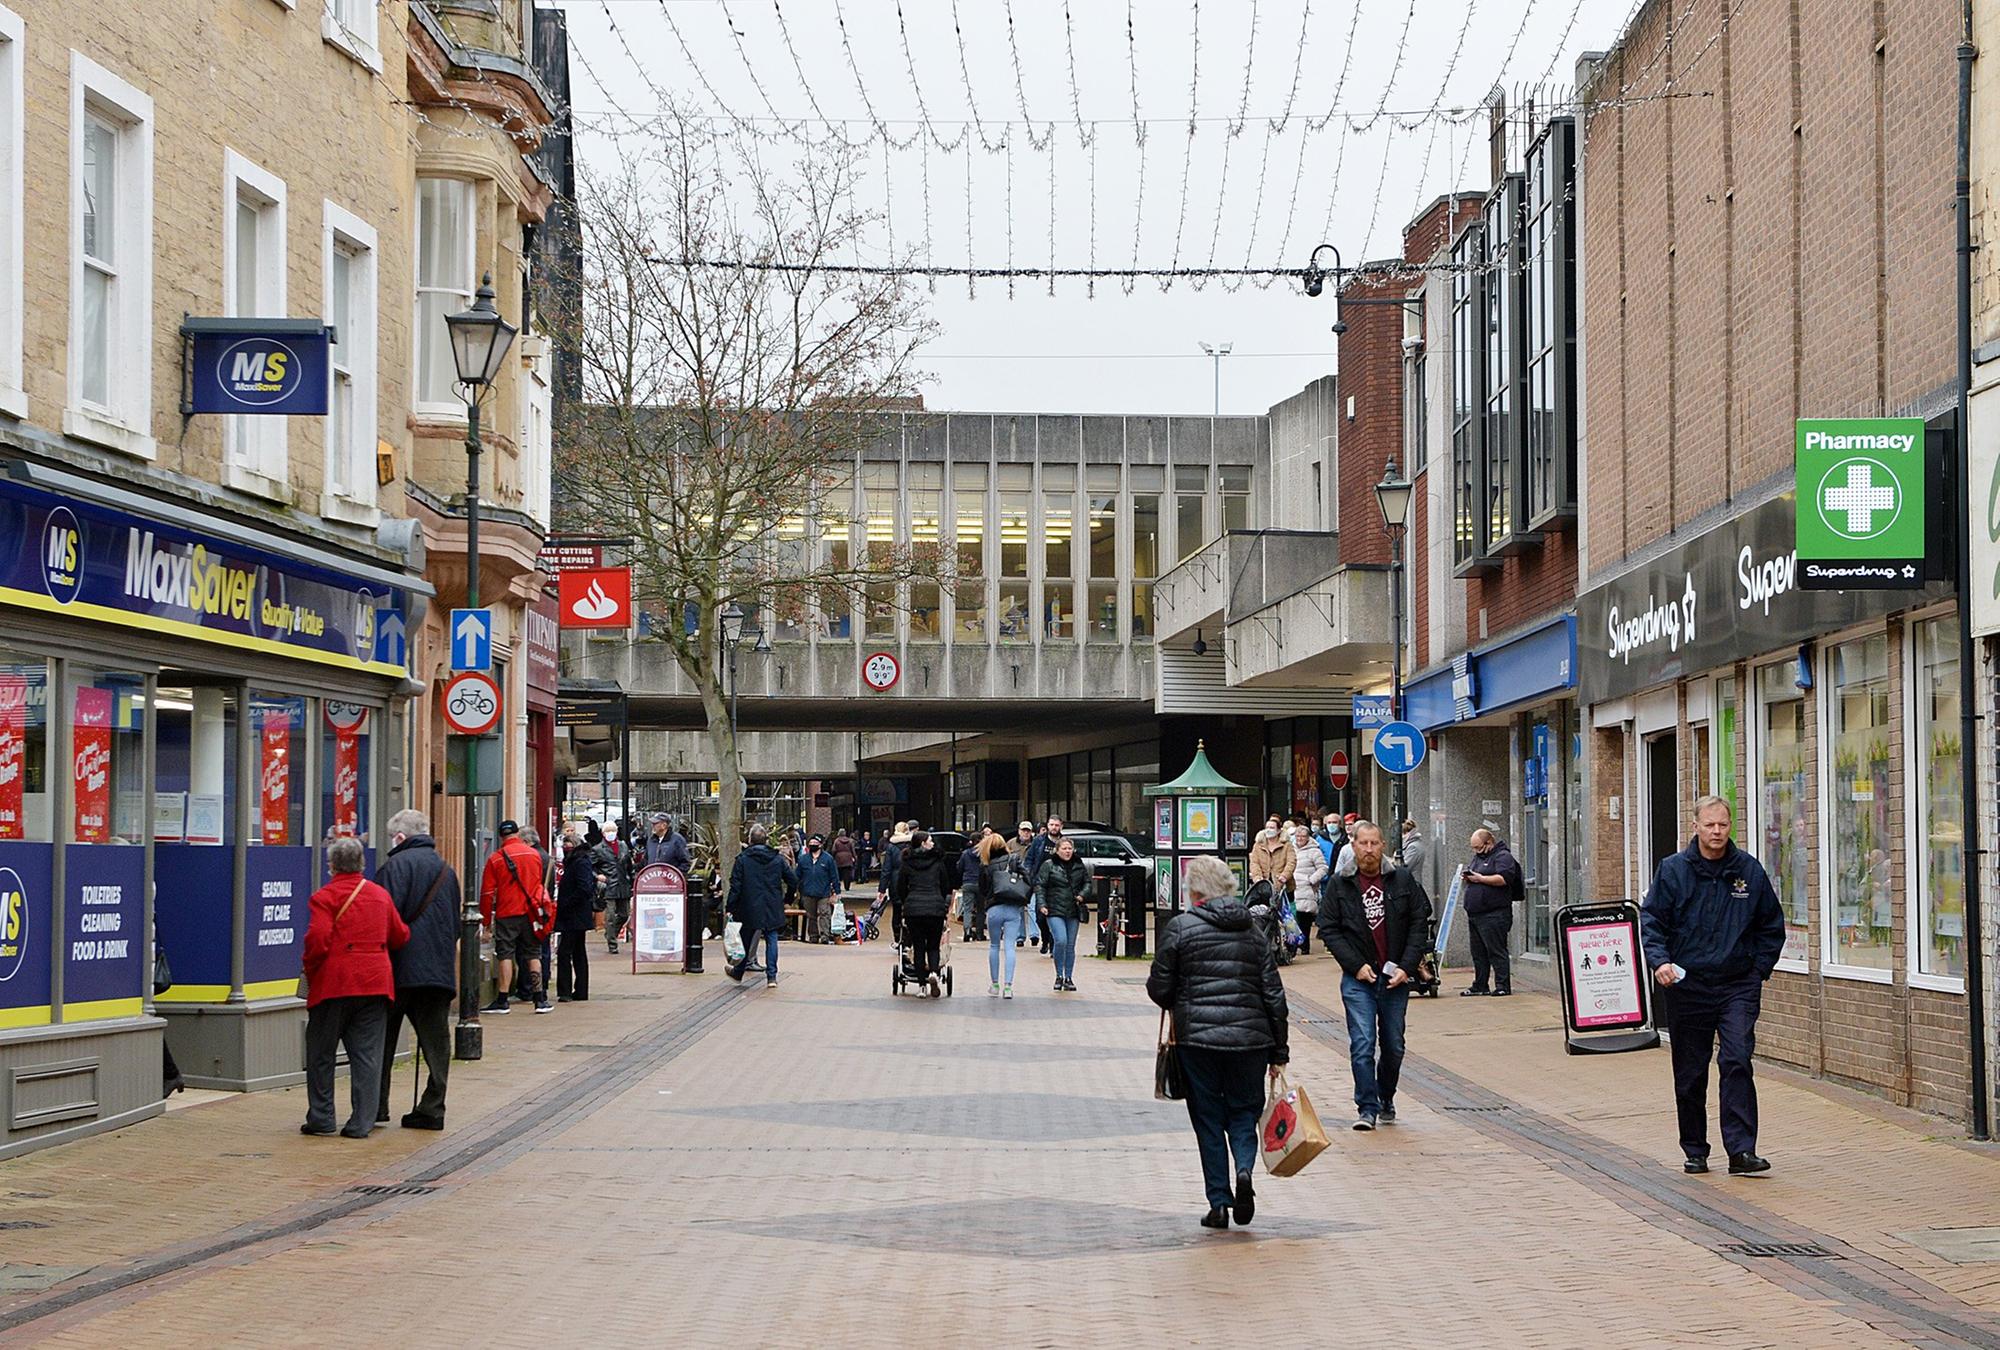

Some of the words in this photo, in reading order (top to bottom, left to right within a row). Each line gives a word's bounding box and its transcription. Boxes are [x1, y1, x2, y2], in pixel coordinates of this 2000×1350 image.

[231, 352, 288, 382] MS
[1805, 432, 1915, 452] Pharmacy
[48, 526, 77, 572] MS
[125, 527, 256, 620] MaxiSaver
[1806, 565, 1897, 579] Superdrug
[262, 598, 295, 636] Quality
[294, 606, 302, 632] &
[301, 608, 325, 637] Value
[356, 603, 374, 638] MS
[1608, 595, 1680, 665] Superdrug
[1355, 708, 1392, 717] HALIFA
[641, 870, 680, 884] TIMPSON
[82, 886, 122, 905] TOILETRIES
[262, 881, 292, 897] SEASONAL
[81, 913, 121, 932] CLEANING
[263, 905, 275, 922] PET
[275, 904, 291, 921] CARE
[1572, 916, 1616, 924] Superdrug
[258, 928, 294, 946] HOUSEHOLD
[72, 941, 96, 961] FOOD
[97, 941, 103, 959] &
[104, 940, 128, 958] DRINK
